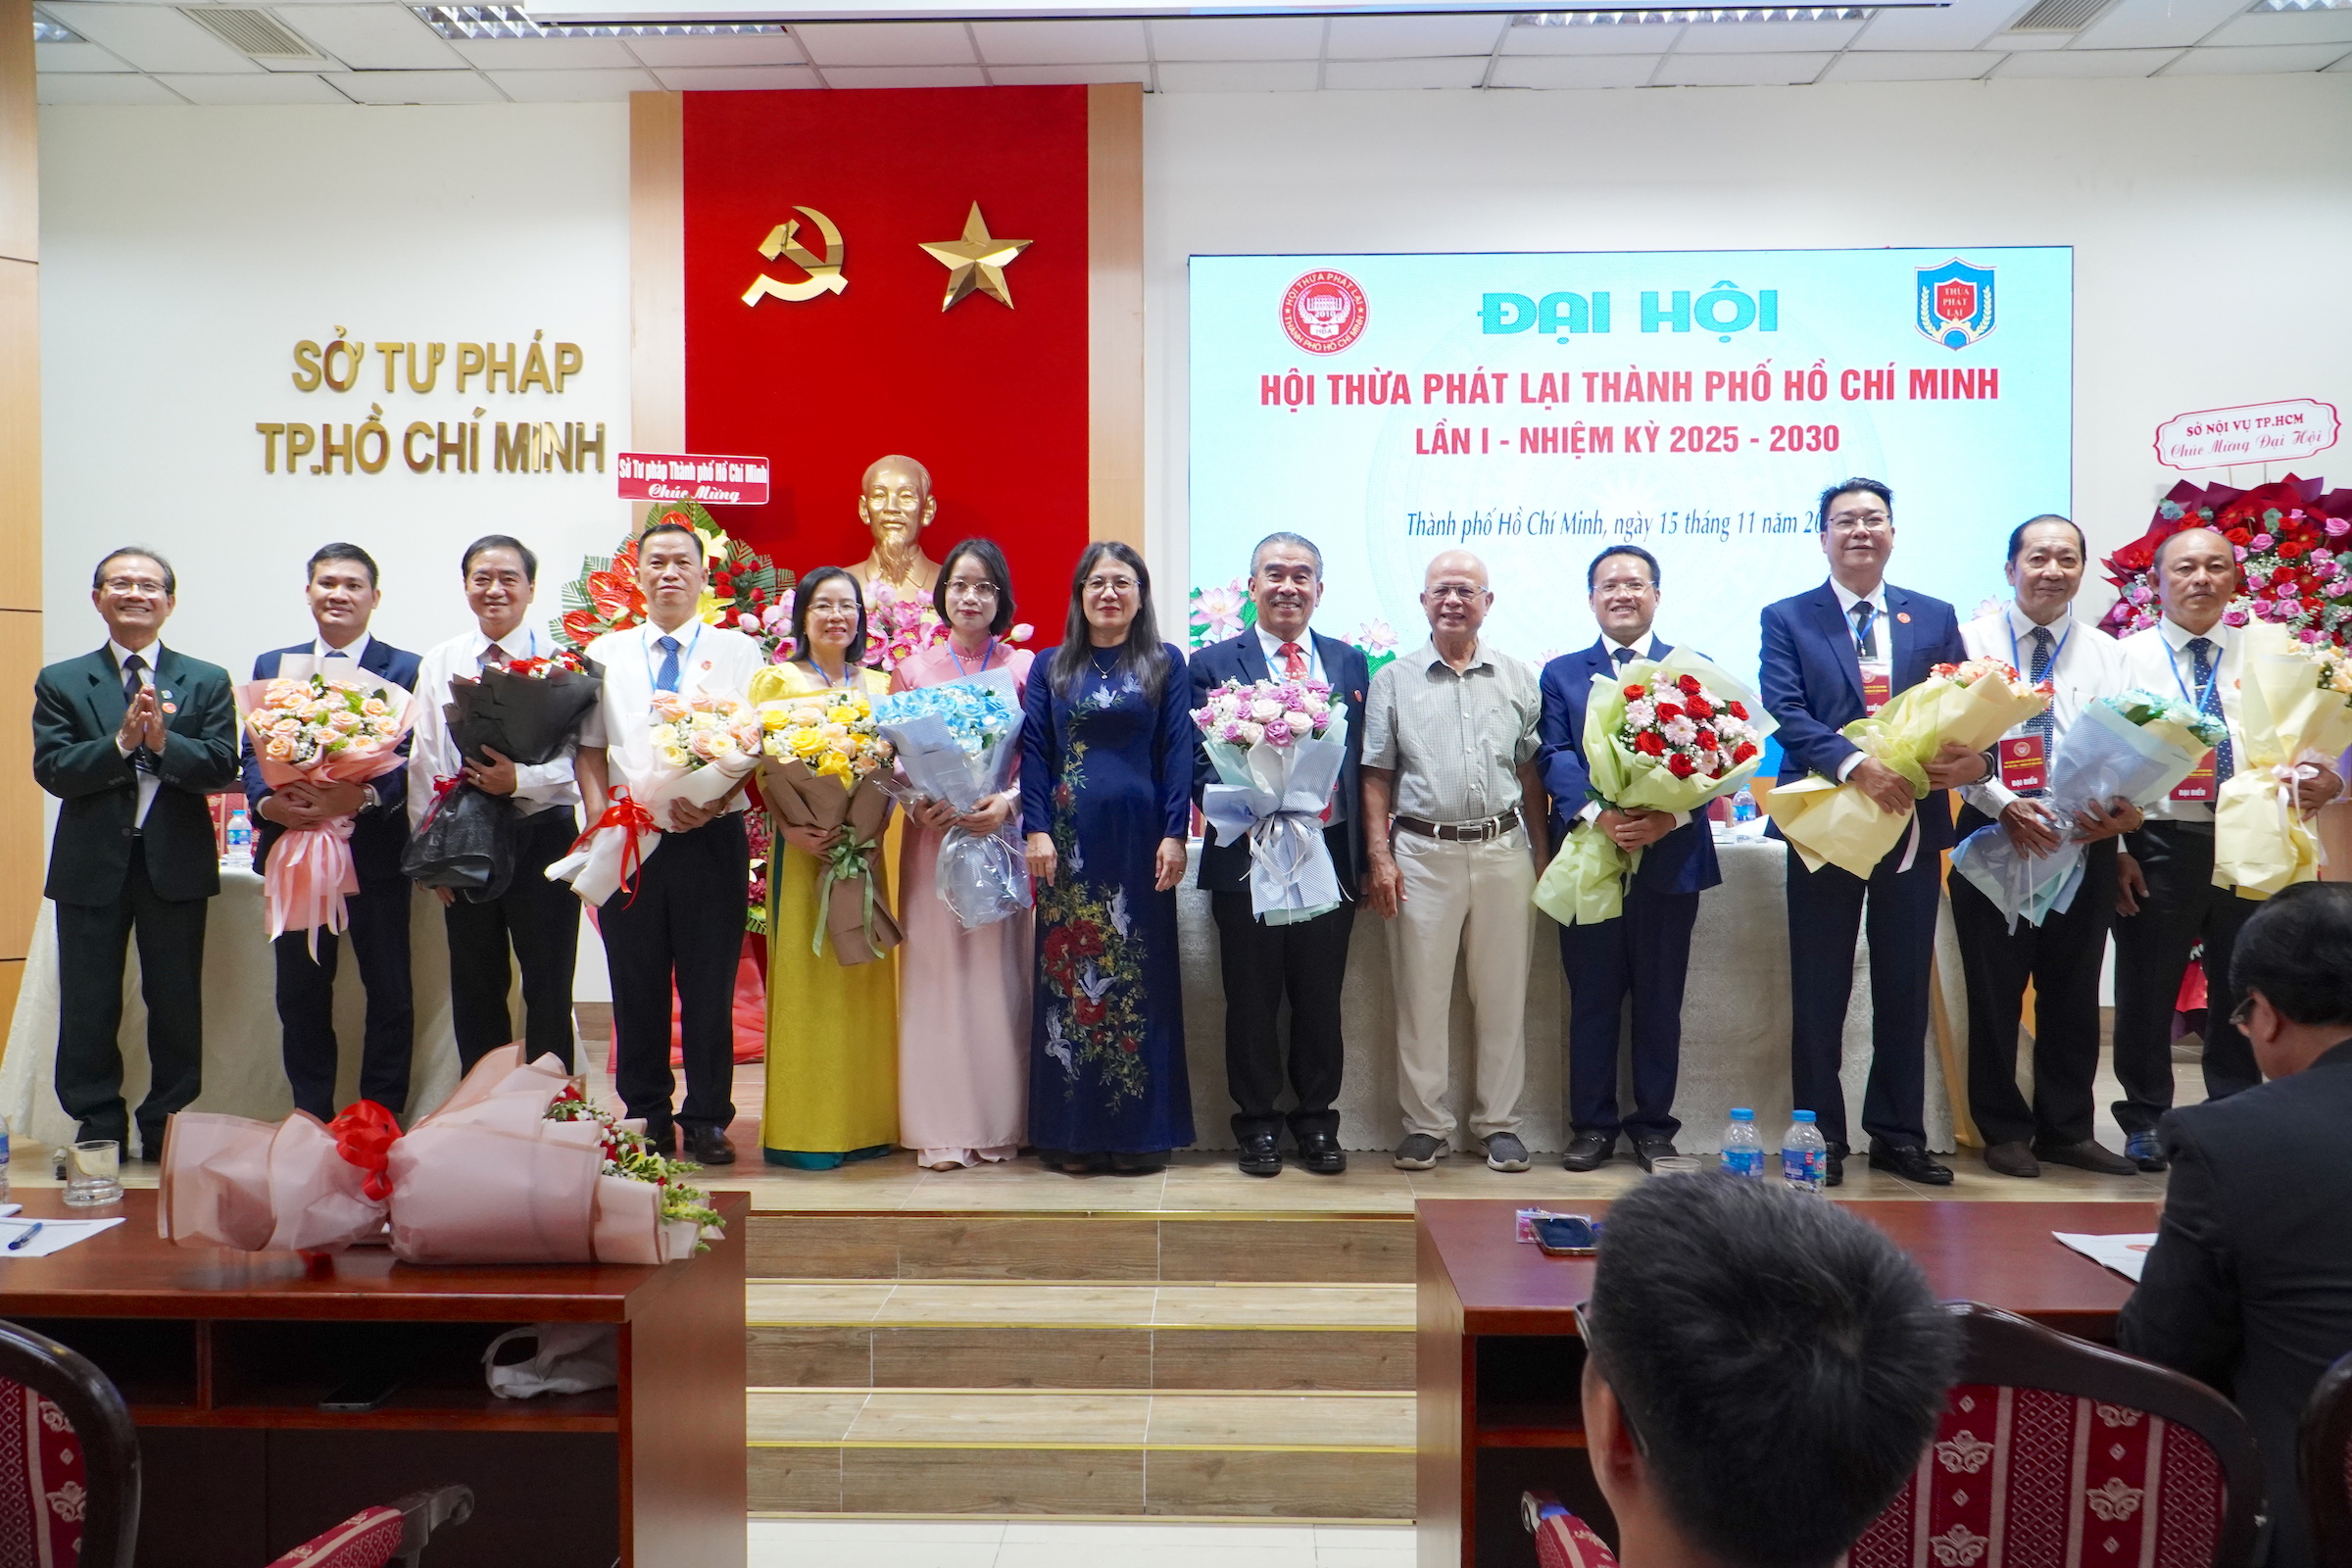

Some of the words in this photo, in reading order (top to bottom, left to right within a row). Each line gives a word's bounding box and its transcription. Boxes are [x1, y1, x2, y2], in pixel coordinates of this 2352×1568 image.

[1477, 291, 1610, 344] ĐẠI
[1641, 280, 1779, 343] HỘI
[291, 324, 365, 393] SỞ
[374, 342, 446, 394] TƯ
[456, 328, 584, 394] PHÁP
[1260, 368, 1315, 413] HỘI
[1327, 367, 1411, 406] THỪA
[1424, 366, 1508, 404] PHÁT
[1521, 371, 1569, 411] LẠI
[1582, 364, 1692, 403] THÀNH
[1705, 358, 1773, 402] PHỐ
[1784, 358, 1828, 401] HỒ
[1840, 362, 1895, 401] CHÍ
[1909, 368, 1998, 400] MINH
[256, 402, 391, 475] TP.HỒ
[403, 407, 487, 475] CHÍ
[493, 421, 606, 474] MINH
[1416, 417, 1470, 455] LẦN
[1481, 427, 1490, 455] I
[1520, 420, 1613, 460] NHIỆM
[1624, 419, 1660, 453] KỲ
[1669, 425, 1739, 453] 2025
[1769, 424, 1839, 452] 2030
[2171, 444, 2204, 458] Chúc
[2208, 439, 2250, 453] Mừng
[2256, 433, 2285, 449] Đại
[2292, 430, 2323, 446] Hội
[2186, 421, 2202, 437] SỞ
[2206, 420, 2229, 436] NỘI
[2232, 419, 2251, 432] VỤ
[2255, 413, 2304, 429] TP.HCM
[618, 457, 632, 478] Sở
[645, 461, 668, 481] pháp
[668, 461, 696, 481] Thành
[697, 460, 714, 483] phố
[714, 461, 728, 482] Hồ
[729, 463, 744, 483] Chí
[745, 465, 767, 484] Minh
[648, 483, 689, 499] Chúc
[691, 485, 741, 503] Mừng
[1407, 511, 1456, 536] Thành
[1461, 507, 1496, 544] phố
[1497, 506, 1523, 536] Hồ
[1527, 510, 1557, 536] Chí
[1560, 509, 1607, 539] Minh,
[1614, 510, 1653, 543] ngày
[1660, 512, 1679, 534] 15
[1685, 509, 1732, 542] tháng
[1738, 511, 1755, 534] 11
[1762, 512, 1797, 534] năm
